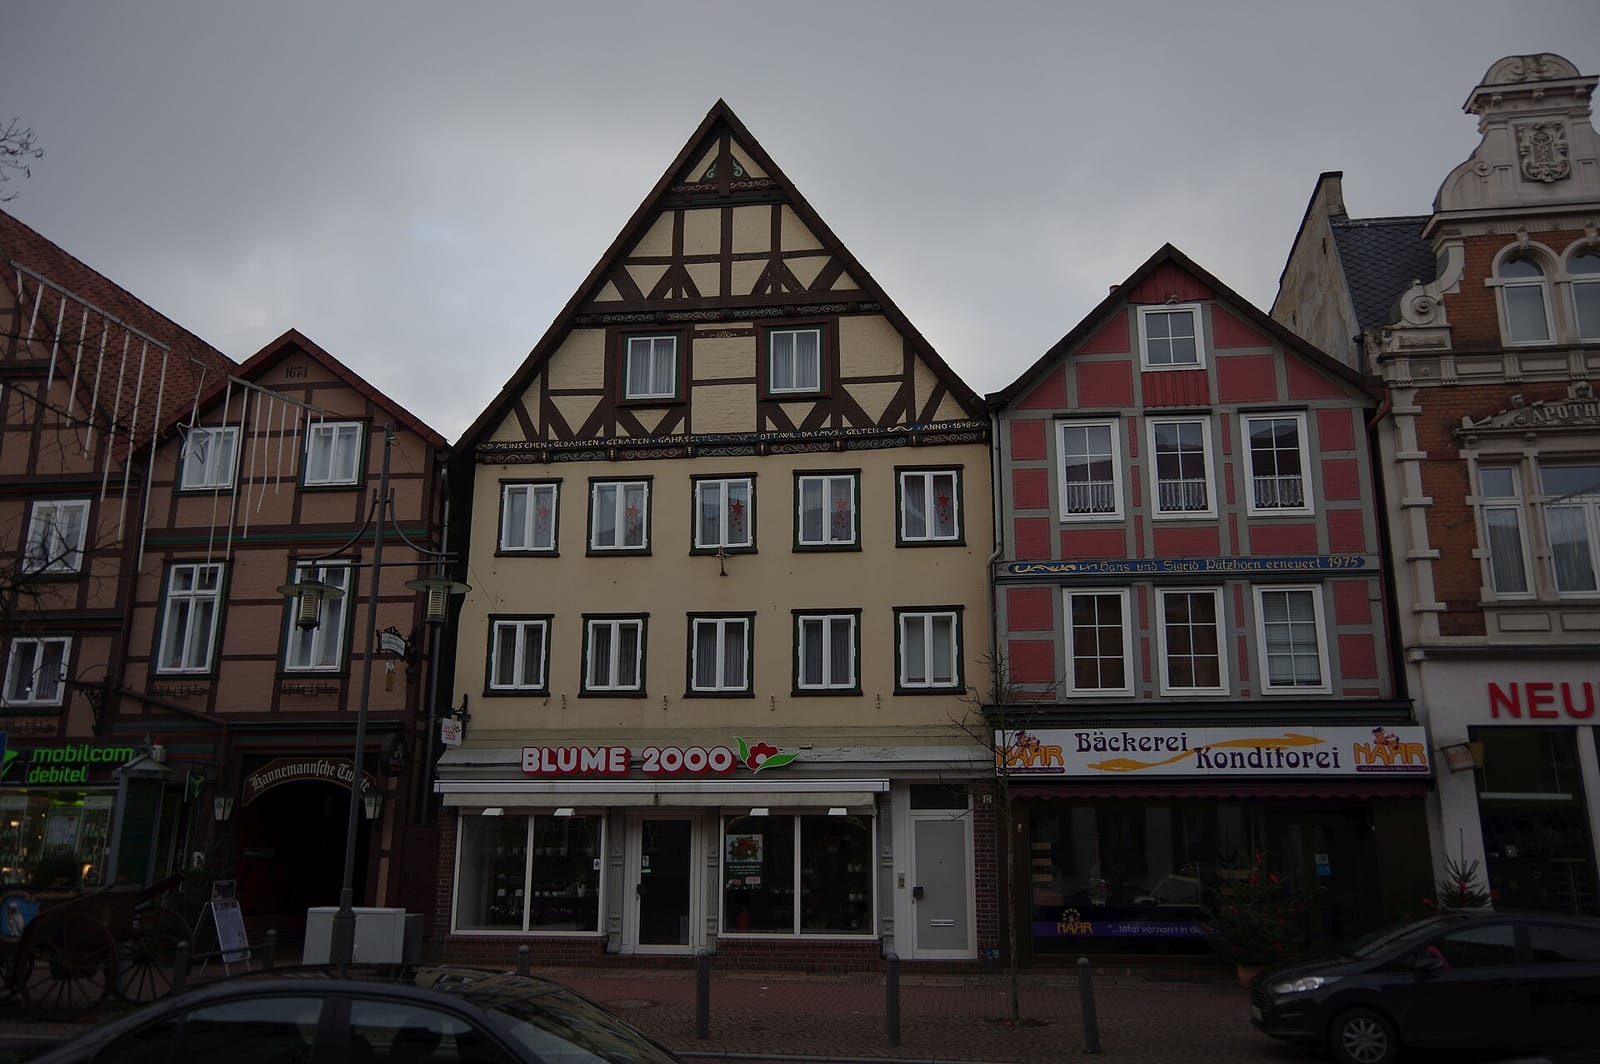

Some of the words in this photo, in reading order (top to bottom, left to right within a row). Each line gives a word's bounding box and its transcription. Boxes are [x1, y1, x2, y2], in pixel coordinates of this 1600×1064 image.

[1533, 403, 1600, 424] APOTH
[922, 423, 948, 432] ANNO
[1265, 558, 1321, 570] erneuert
[1327, 556, 1359, 569] 1975
[1488, 682, 1600, 719] NEU
[1075, 732, 1188, 752] Bäckerei
[32, 743, 135, 763] mobilcom
[520, 746, 632, 777] BLUME
[640, 745, 737, 776] 2000
[1193, 747, 1341, 769] Konditorei
[28, 764, 89, 784] debitel
